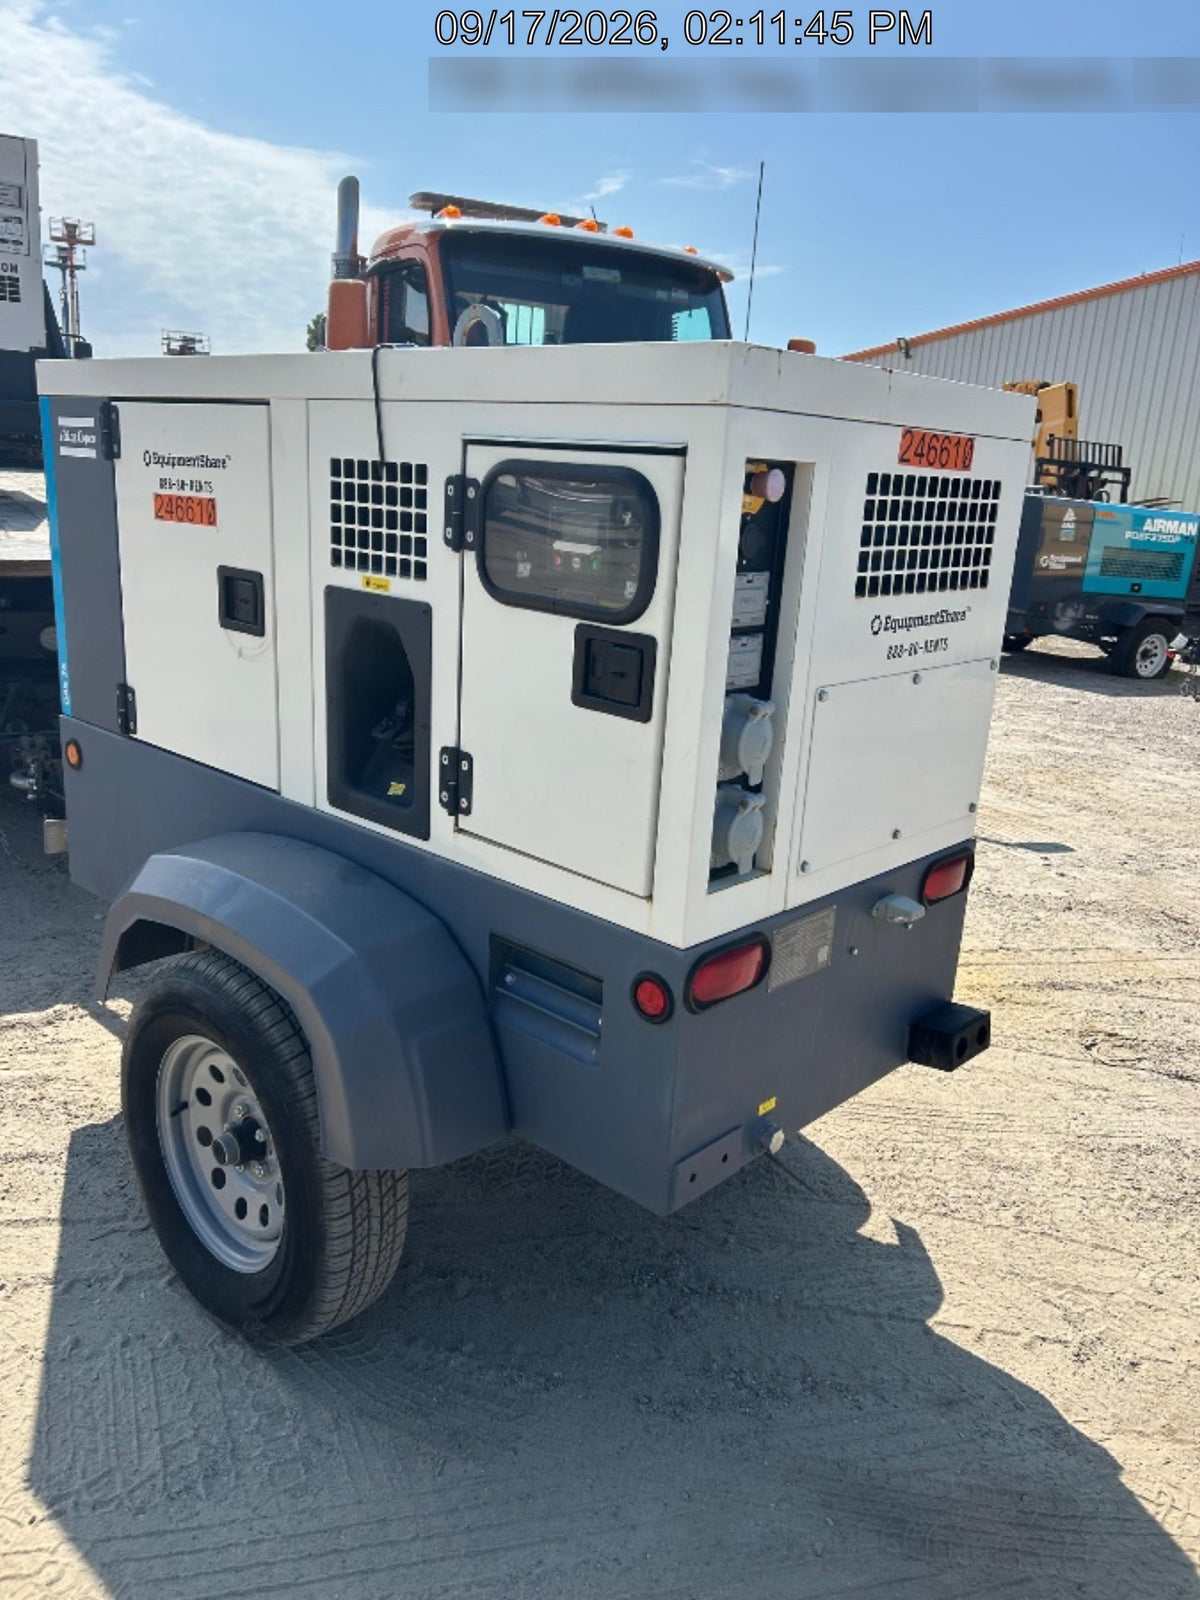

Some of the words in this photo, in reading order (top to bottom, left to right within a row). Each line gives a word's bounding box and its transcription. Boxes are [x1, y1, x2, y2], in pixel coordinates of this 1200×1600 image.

[899, 429, 975, 469] 246610
[154, 494, 217, 525] 246610
[1142, 518, 1198, 536] AIRMAN
[883, 608, 967, 633] EquipmentShare
